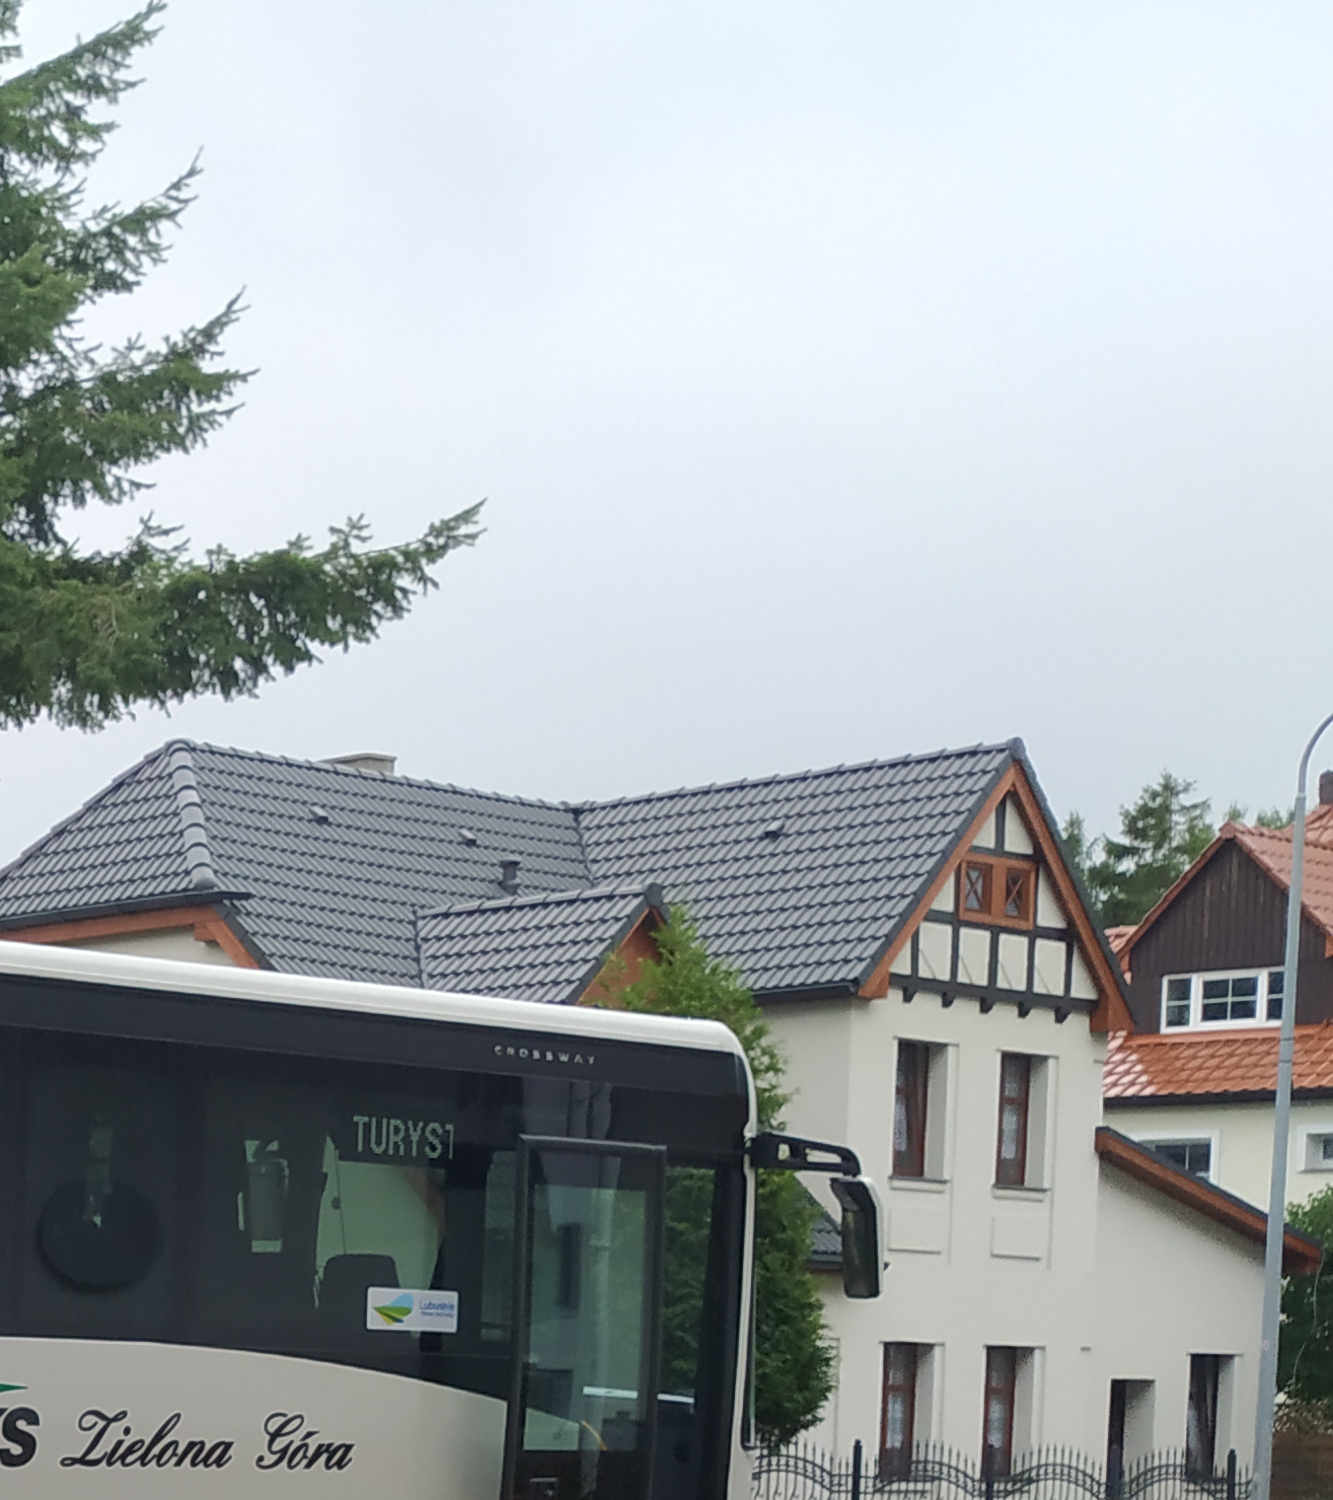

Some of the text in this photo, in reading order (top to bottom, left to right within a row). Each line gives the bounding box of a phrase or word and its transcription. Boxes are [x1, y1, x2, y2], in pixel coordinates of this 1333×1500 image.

[494, 1045, 595, 1065] CROSSWAY
[59, 1409, 235, 1469] Zielona
[255, 1412, 355, 1471] Góra
